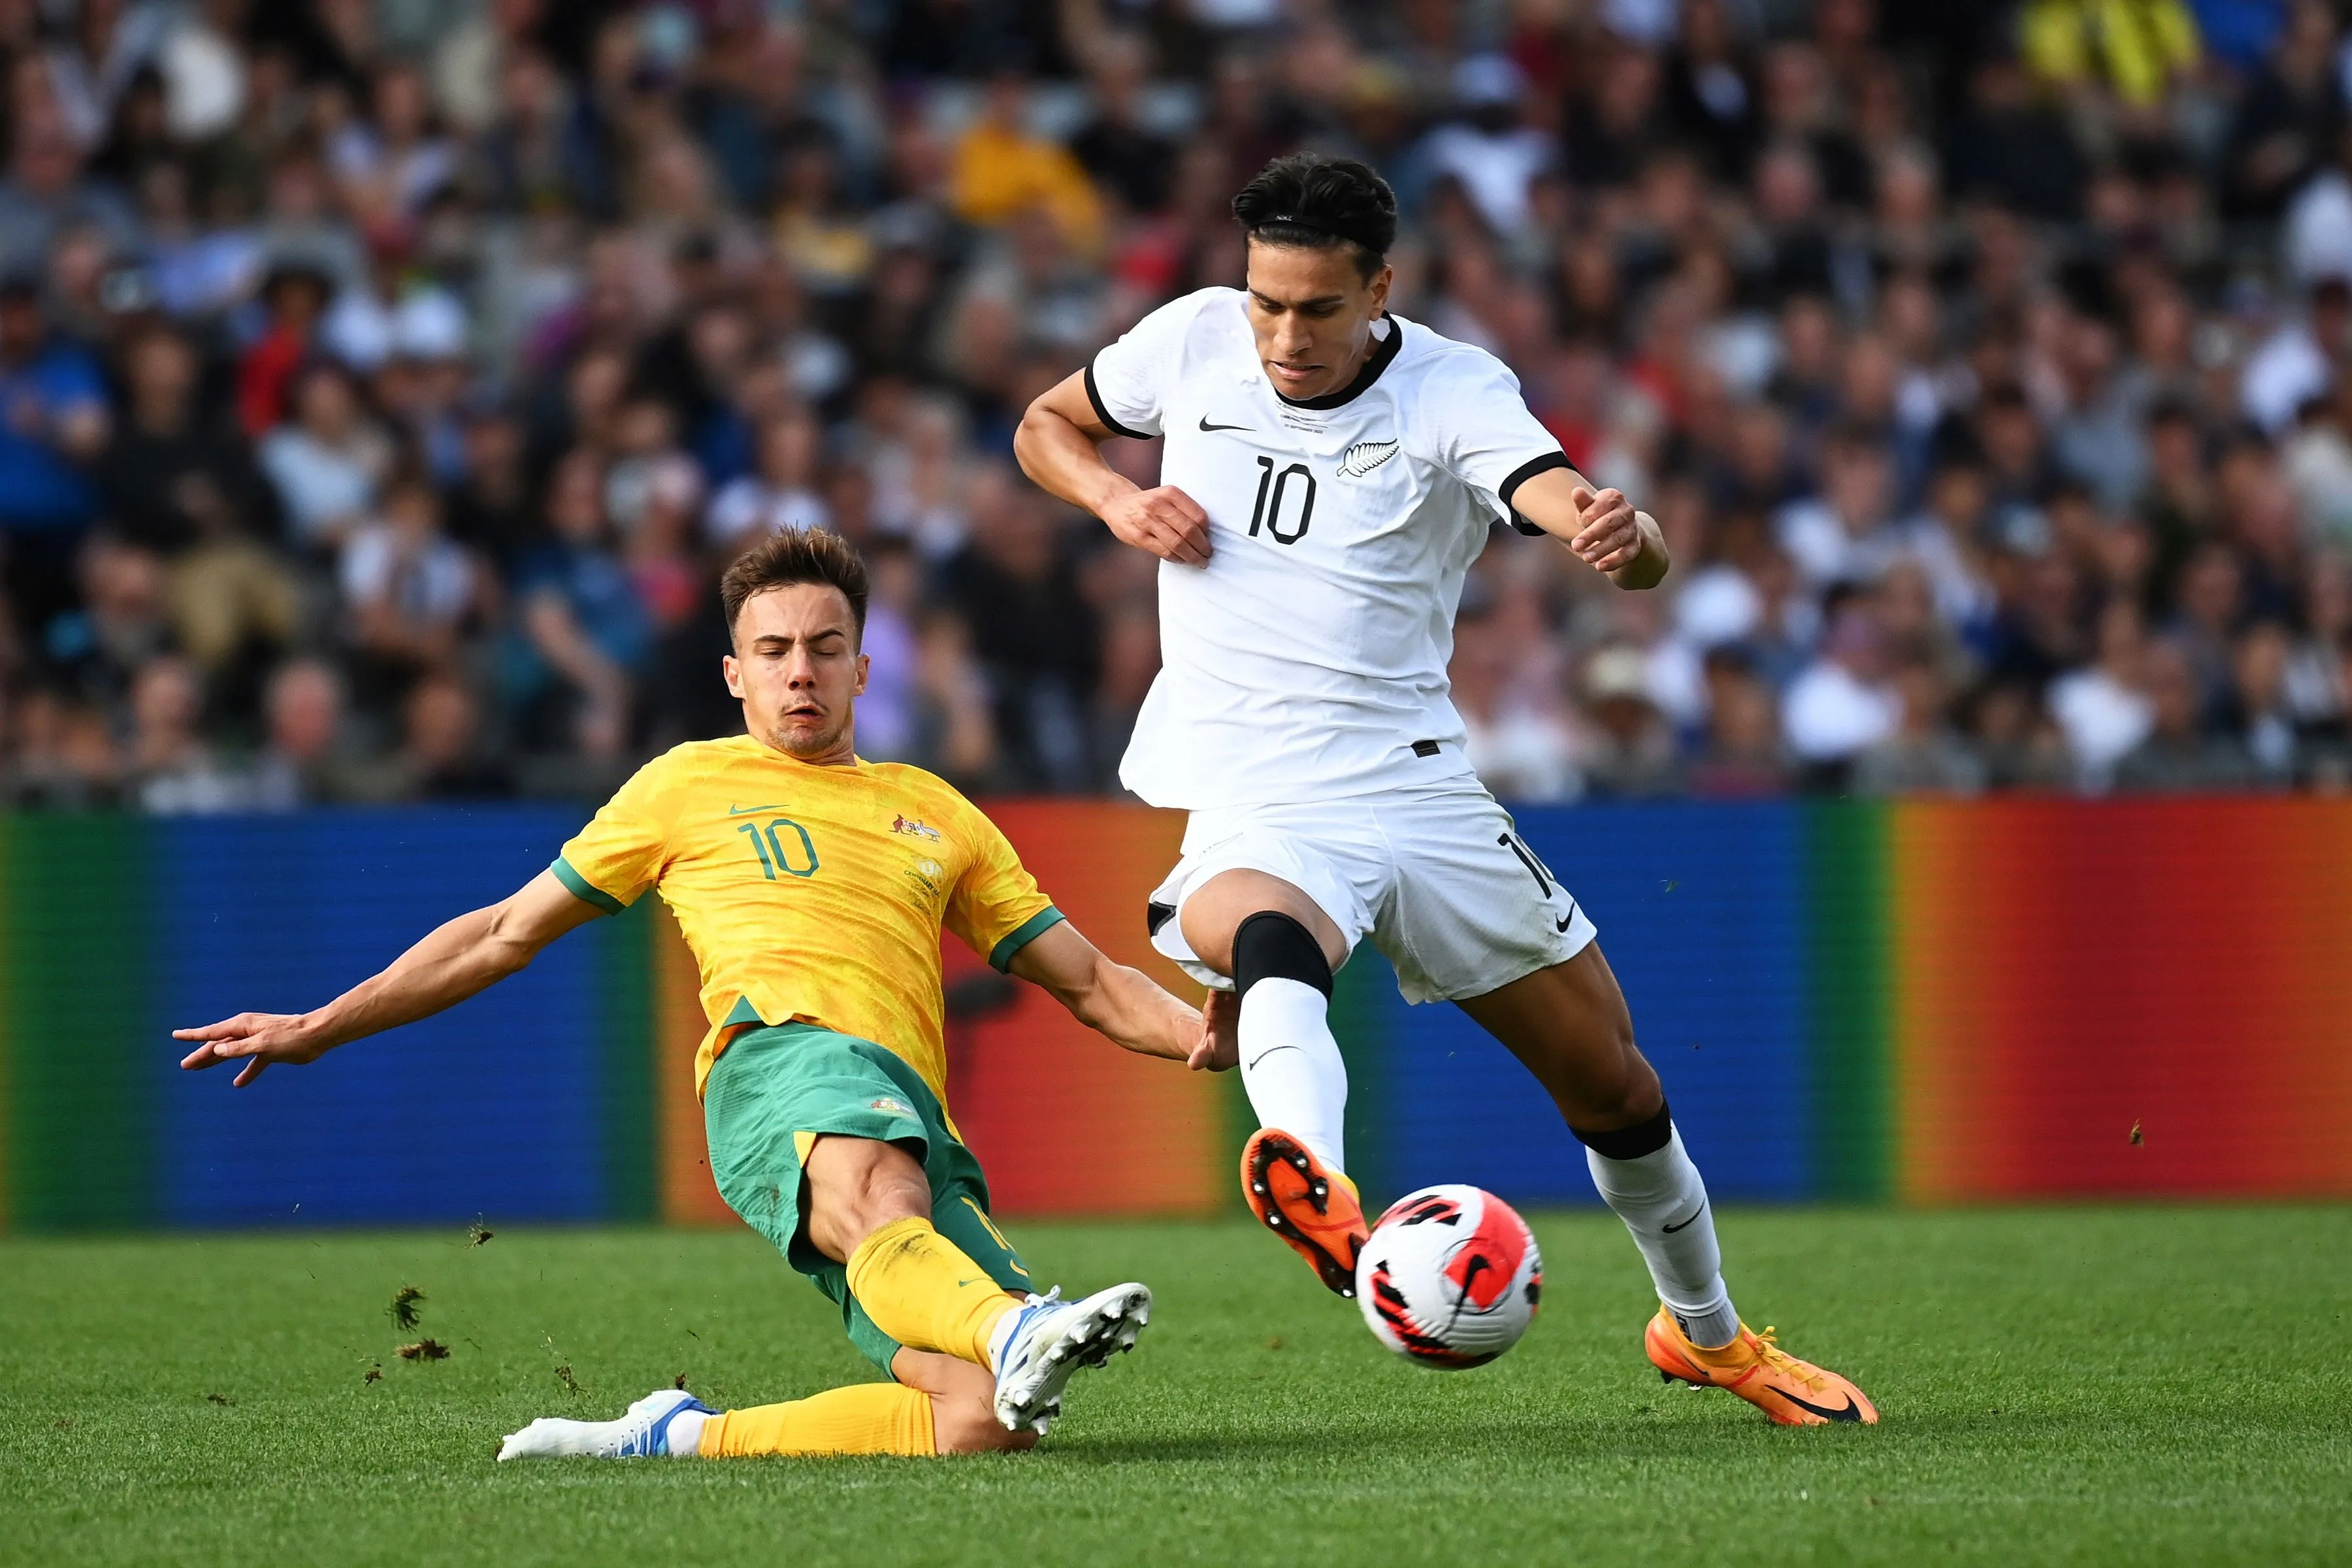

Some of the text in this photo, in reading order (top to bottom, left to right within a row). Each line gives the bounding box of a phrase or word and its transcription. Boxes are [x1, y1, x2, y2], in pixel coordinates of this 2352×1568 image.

[1249, 455, 1316, 546] 10
[737, 819, 820, 881] 10
[960, 1196, 1017, 1254] 1
